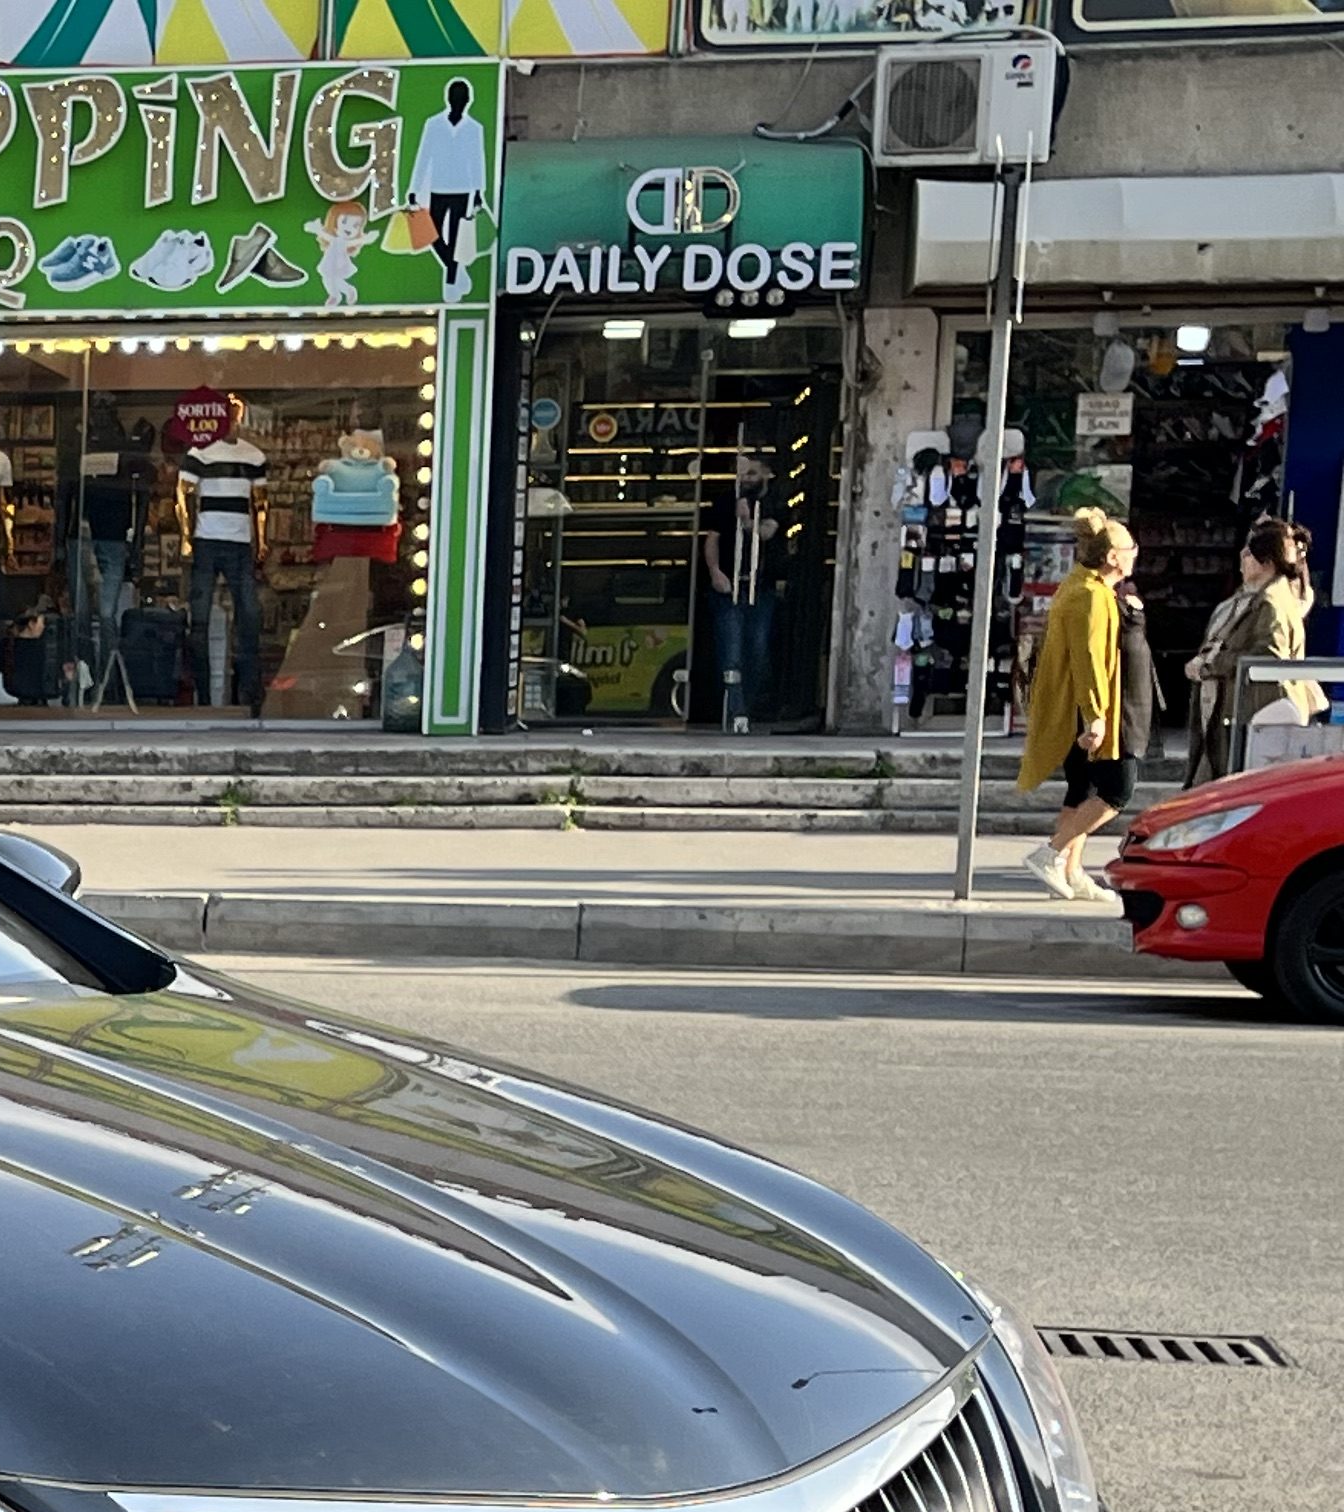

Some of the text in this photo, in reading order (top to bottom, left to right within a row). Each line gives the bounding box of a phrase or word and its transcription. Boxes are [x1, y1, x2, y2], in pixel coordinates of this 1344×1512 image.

[505, 241, 859, 295] DAILY DOSE
[187, 420, 218, 433] 4.00
